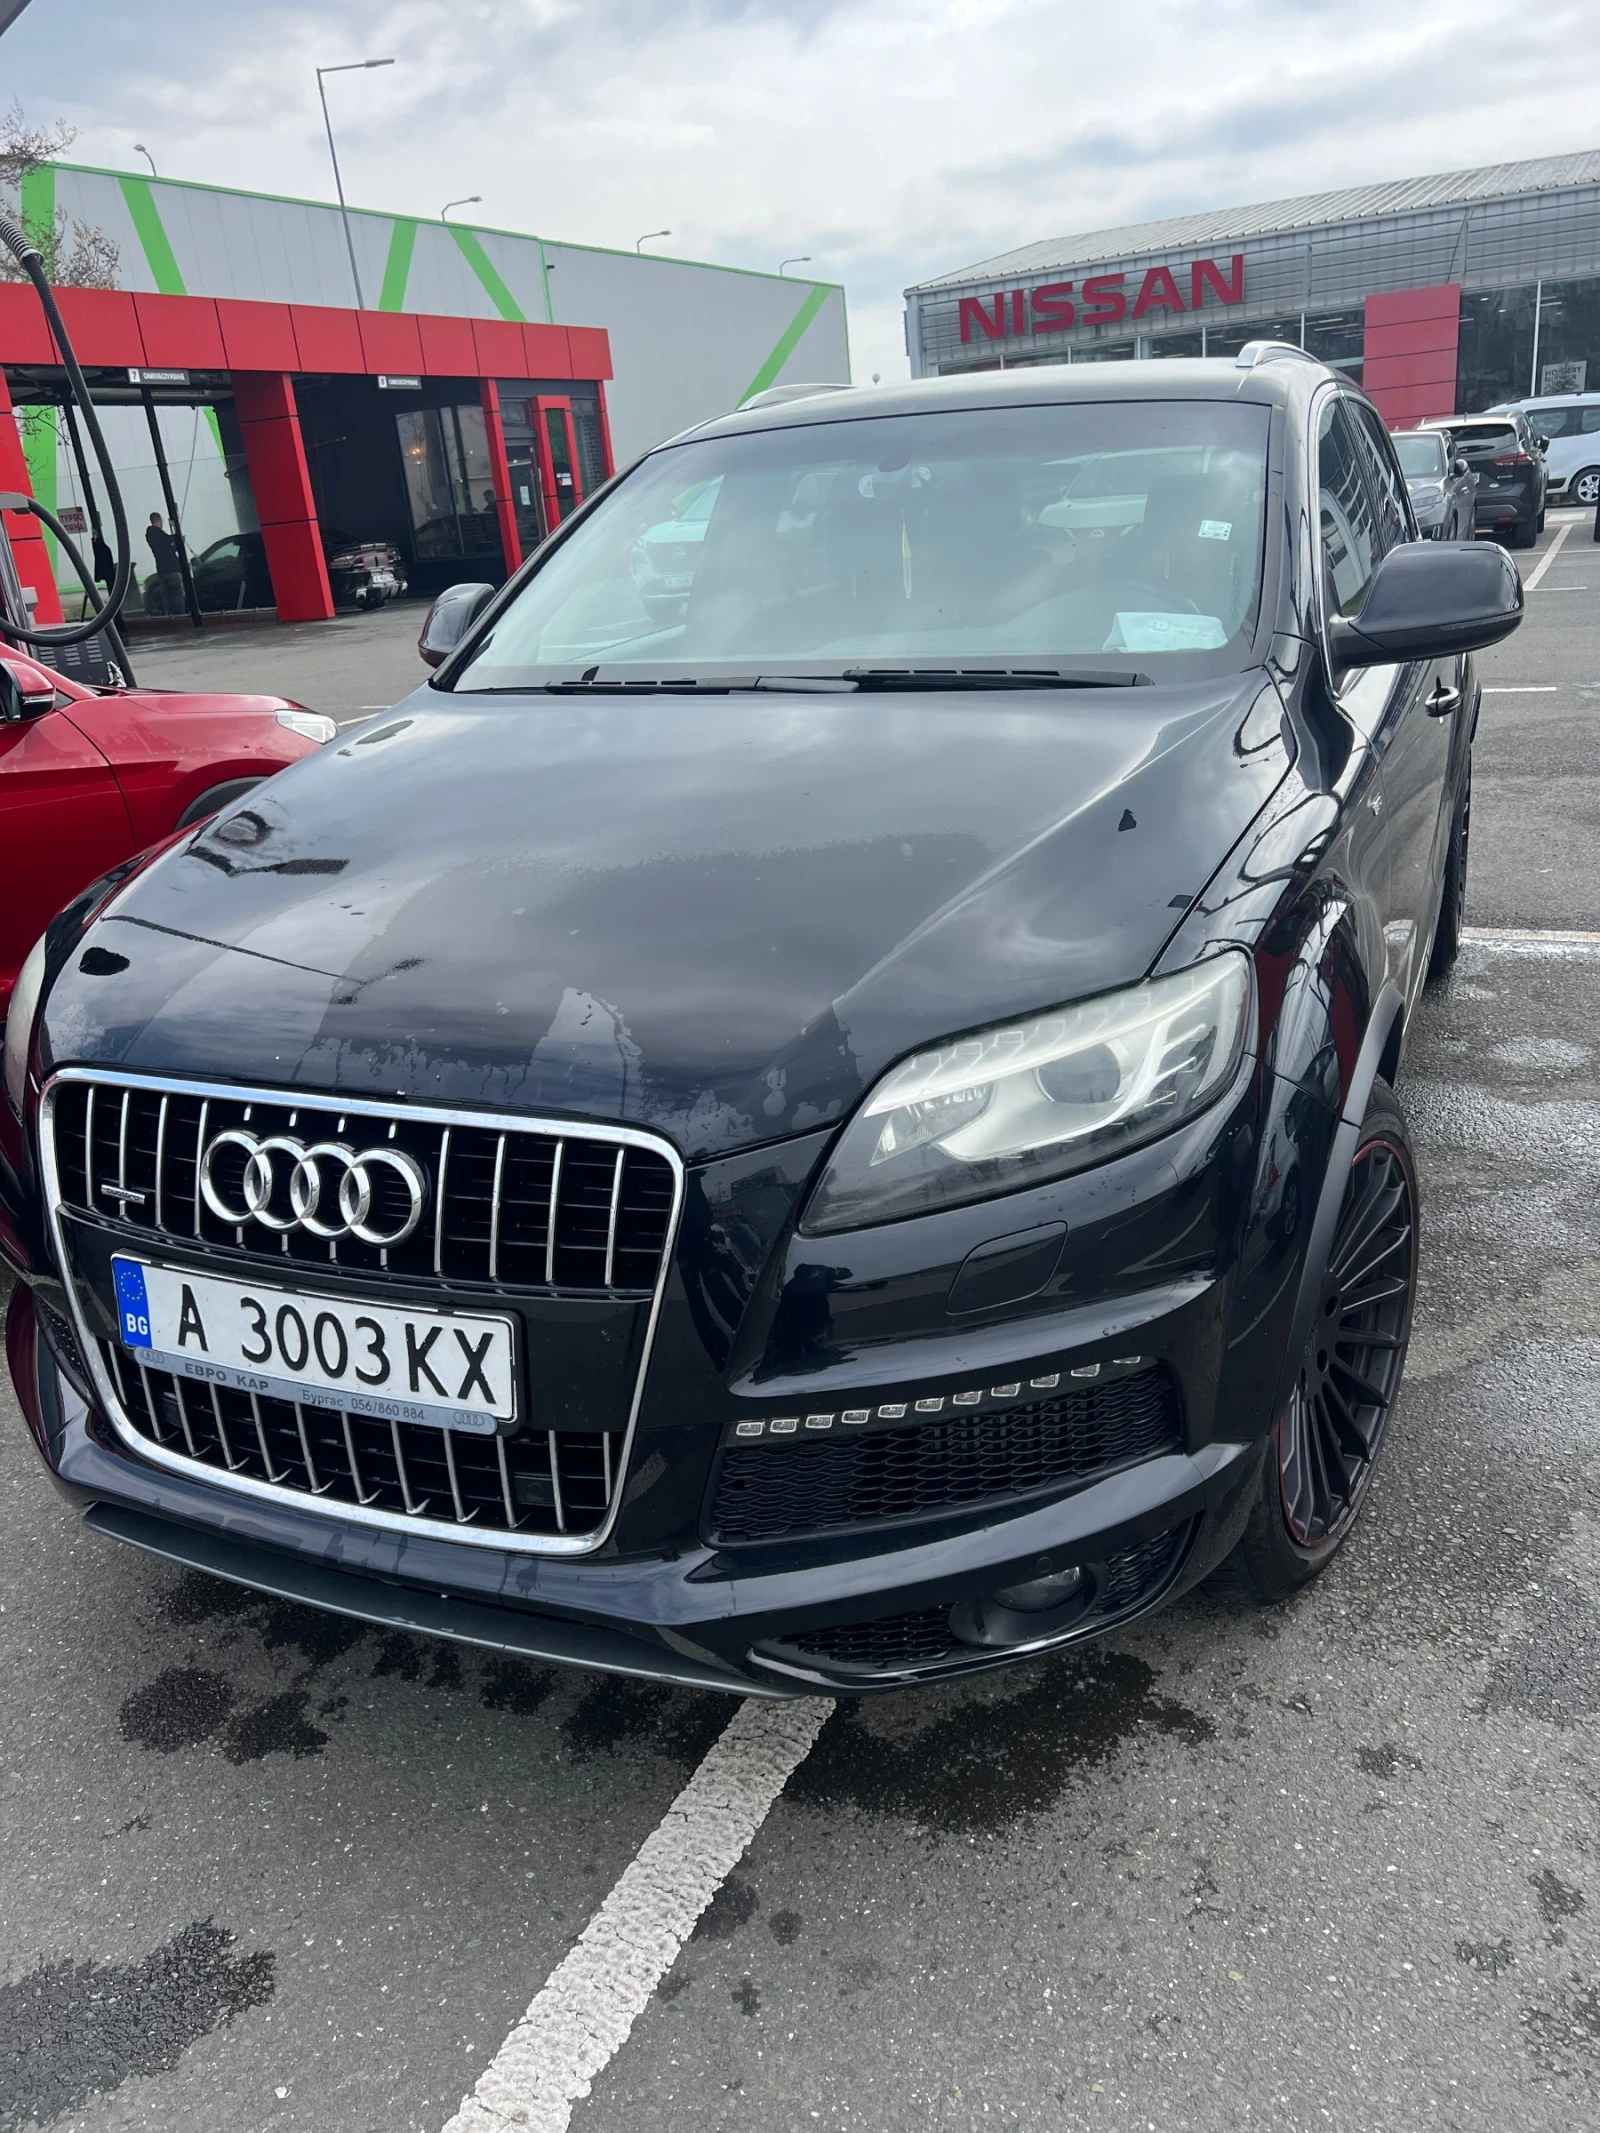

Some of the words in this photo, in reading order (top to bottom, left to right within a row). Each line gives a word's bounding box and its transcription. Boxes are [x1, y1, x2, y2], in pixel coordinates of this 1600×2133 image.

[958, 254, 1244, 343] NISSAN
[131, 371, 137, 380] 7
[60, 513, 83, 523] ТУРБО
[106, 1188, 140, 1201] quattro
[126, 1313, 149, 1336] BG
[178, 1283, 209, 1352] A
[184, 1362, 227, 1382] ЕВРО
[236, 1374, 269, 1391] КАР
[302, 1389, 344, 1406] Бургас
[351, 1398, 399, 1417] 056/860
[403, 1407, 425, 1421] 884
